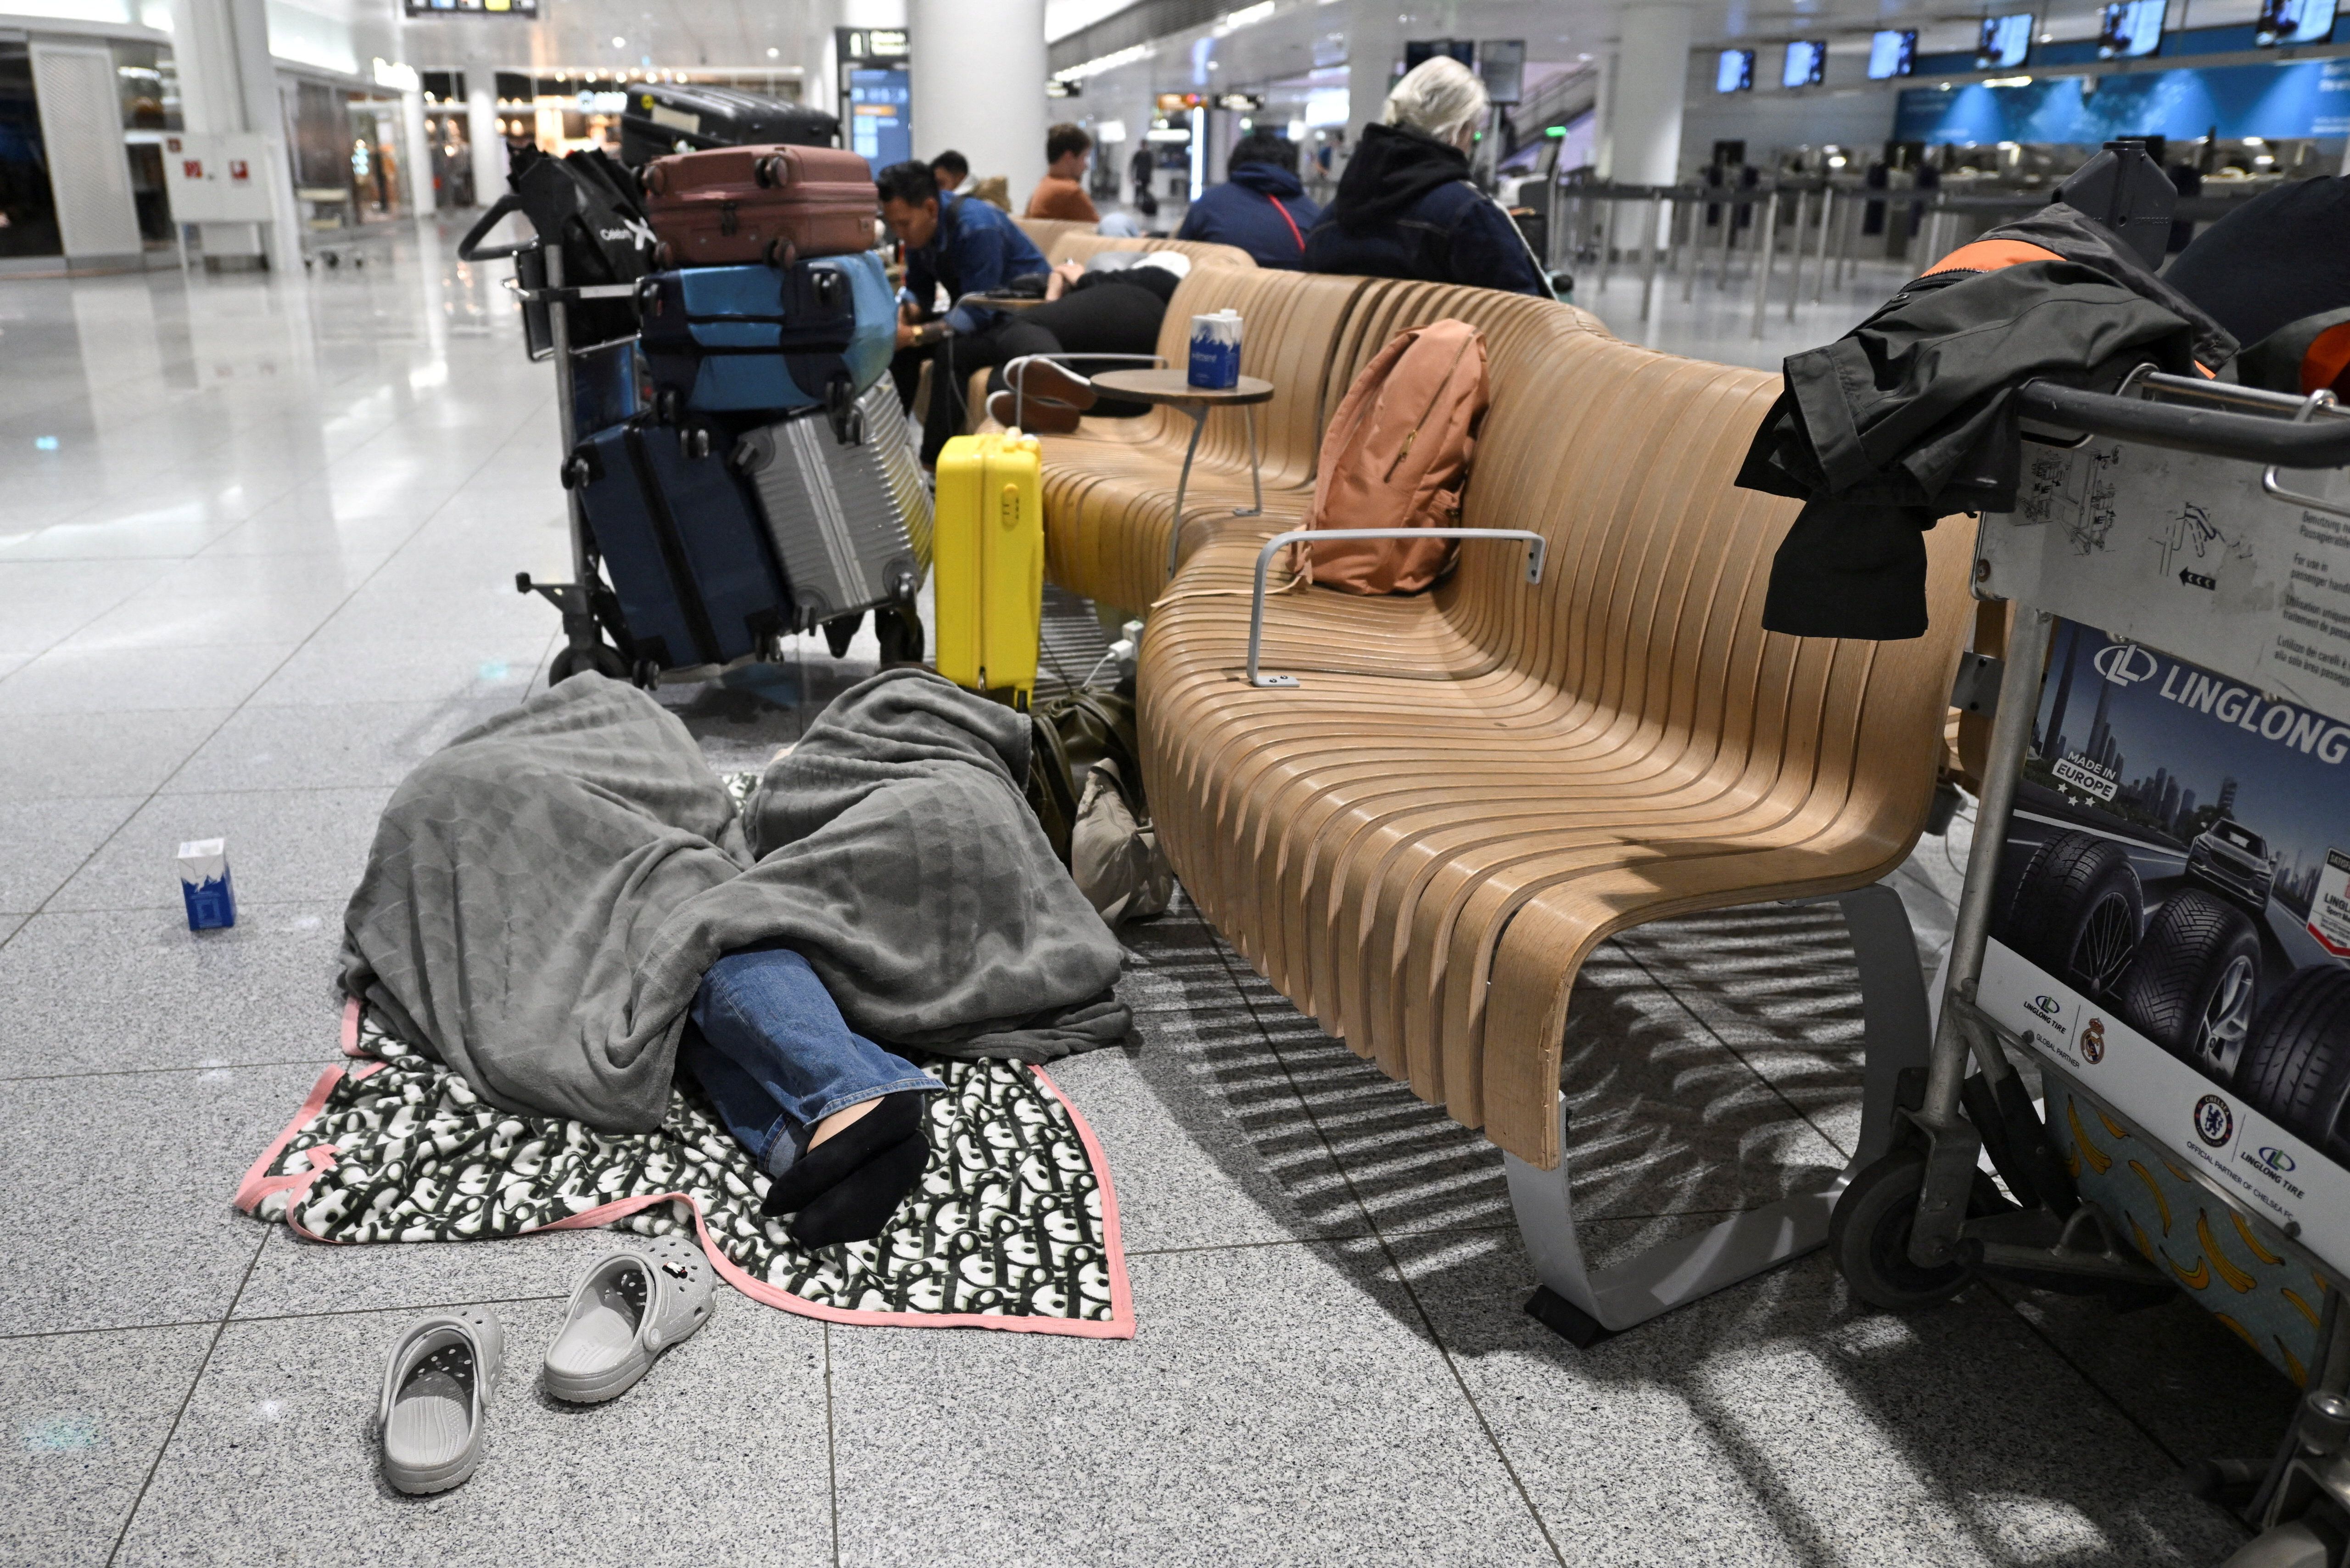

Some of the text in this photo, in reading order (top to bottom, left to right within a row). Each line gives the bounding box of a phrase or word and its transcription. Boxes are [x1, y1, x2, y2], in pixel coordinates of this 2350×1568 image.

[2160, 665, 2350, 764] LINGLONG
[2057, 763, 2113, 797] EUROPE
[2068, 751, 2116, 780] MADE IN
[2023, 1001, 2066, 1034] LINGLONG TIRE
[2037, 1034, 2080, 1069] GLOBAL PARTNER
[2205, 1096, 2230, 1116] CHELSEA
[2187, 1141, 2294, 1221] OFFICIAL PARTNER OF CHELSEA FC
[2240, 1151, 2305, 1199] LINGLONG TIRE
